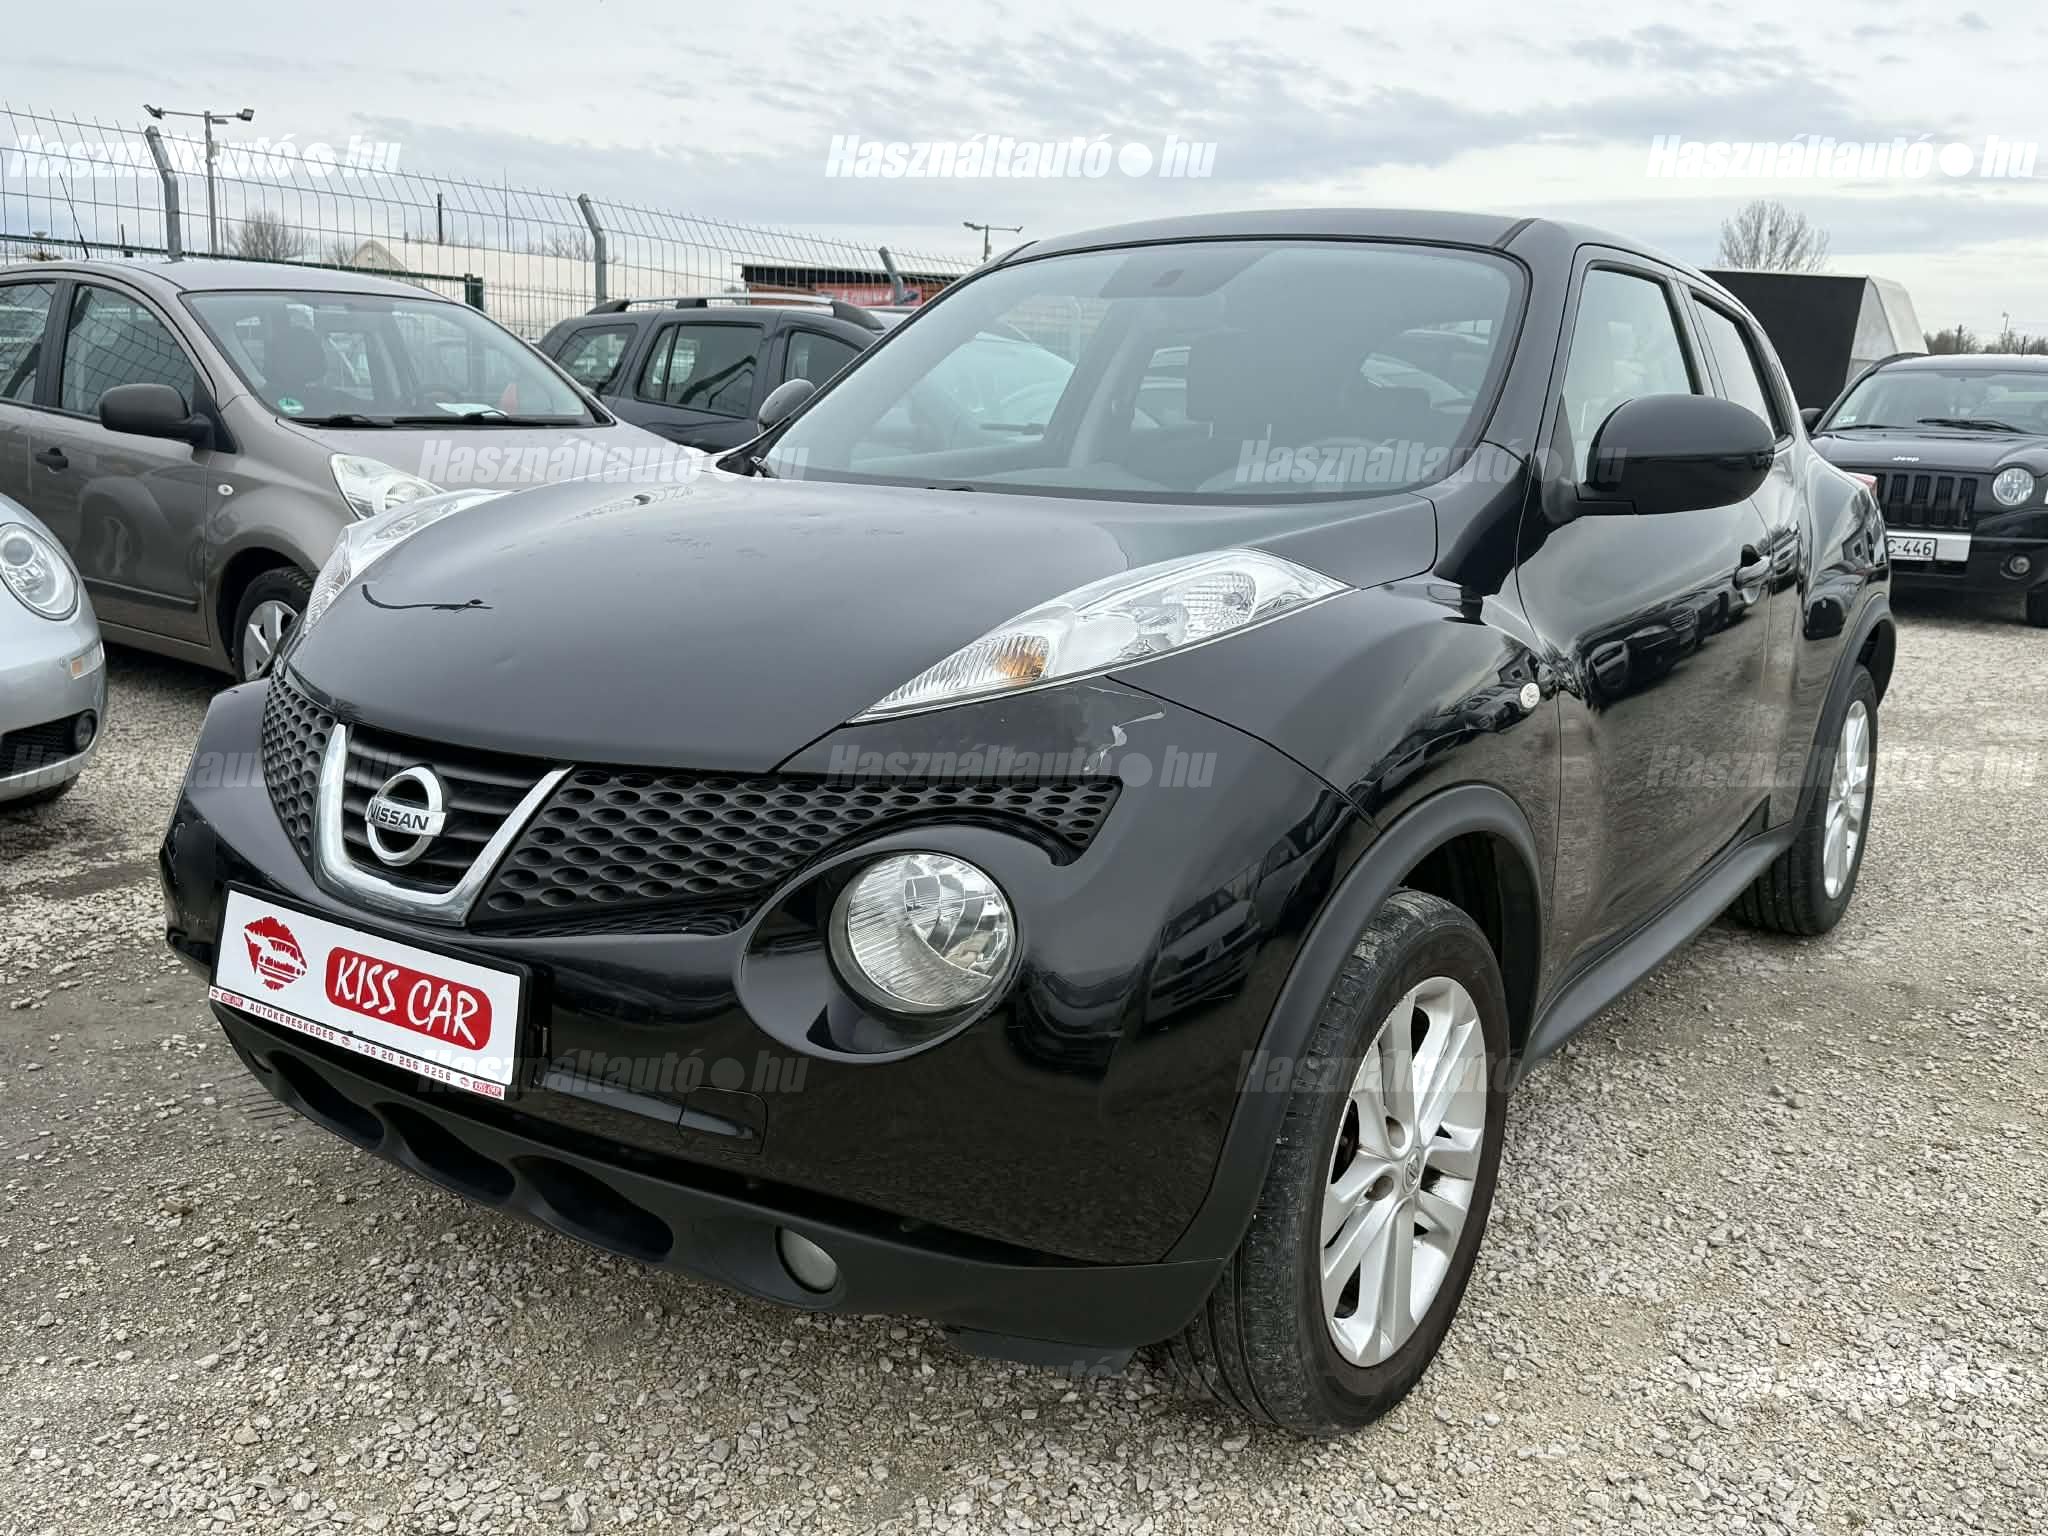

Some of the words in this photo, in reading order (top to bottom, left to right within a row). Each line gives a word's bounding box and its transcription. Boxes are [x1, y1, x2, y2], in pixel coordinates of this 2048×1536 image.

[368, 803, 429, 830] NISSAN
[334, 956, 399, 1015] KISS
[407, 979, 479, 1045] CAR
[381, 1049, 394, 1062] 20
[399, 1055, 418, 1071] 256
[424, 1064, 451, 1081] 8256
